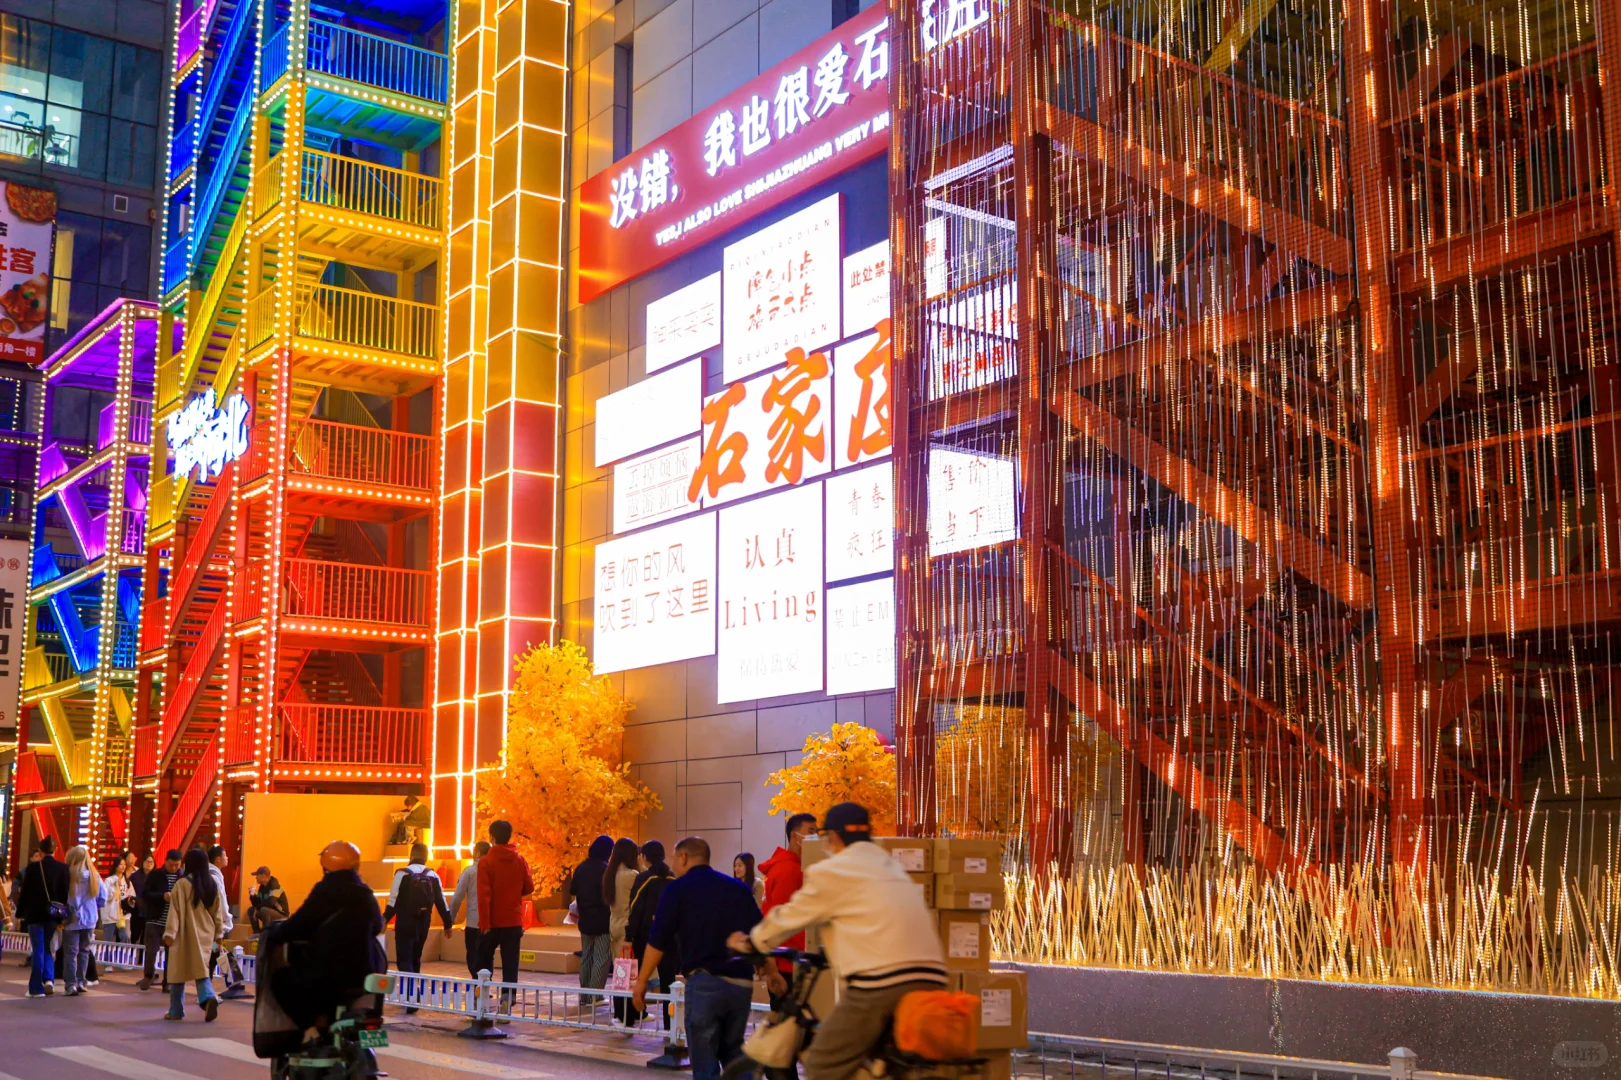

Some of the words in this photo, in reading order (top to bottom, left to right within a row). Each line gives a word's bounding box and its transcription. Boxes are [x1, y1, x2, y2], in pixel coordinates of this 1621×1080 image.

[684, 206, 712, 231] ALSO
[713, 188, 744, 216] LOVE
[834, 121, 871, 152] VERY
[0, 242, 36, 275] 客
[850, 263, 891, 289] 此处禁
[0, 341, 36, 357] 角一楼
[847, 482, 887, 519] 青春
[743, 528, 795, 571] 认真
[847, 528, 888, 561] 疯狂
[599, 543, 686, 593] 想你的风
[599, 579, 710, 634] 吹到了这里
[723, 590, 817, 629] Living
